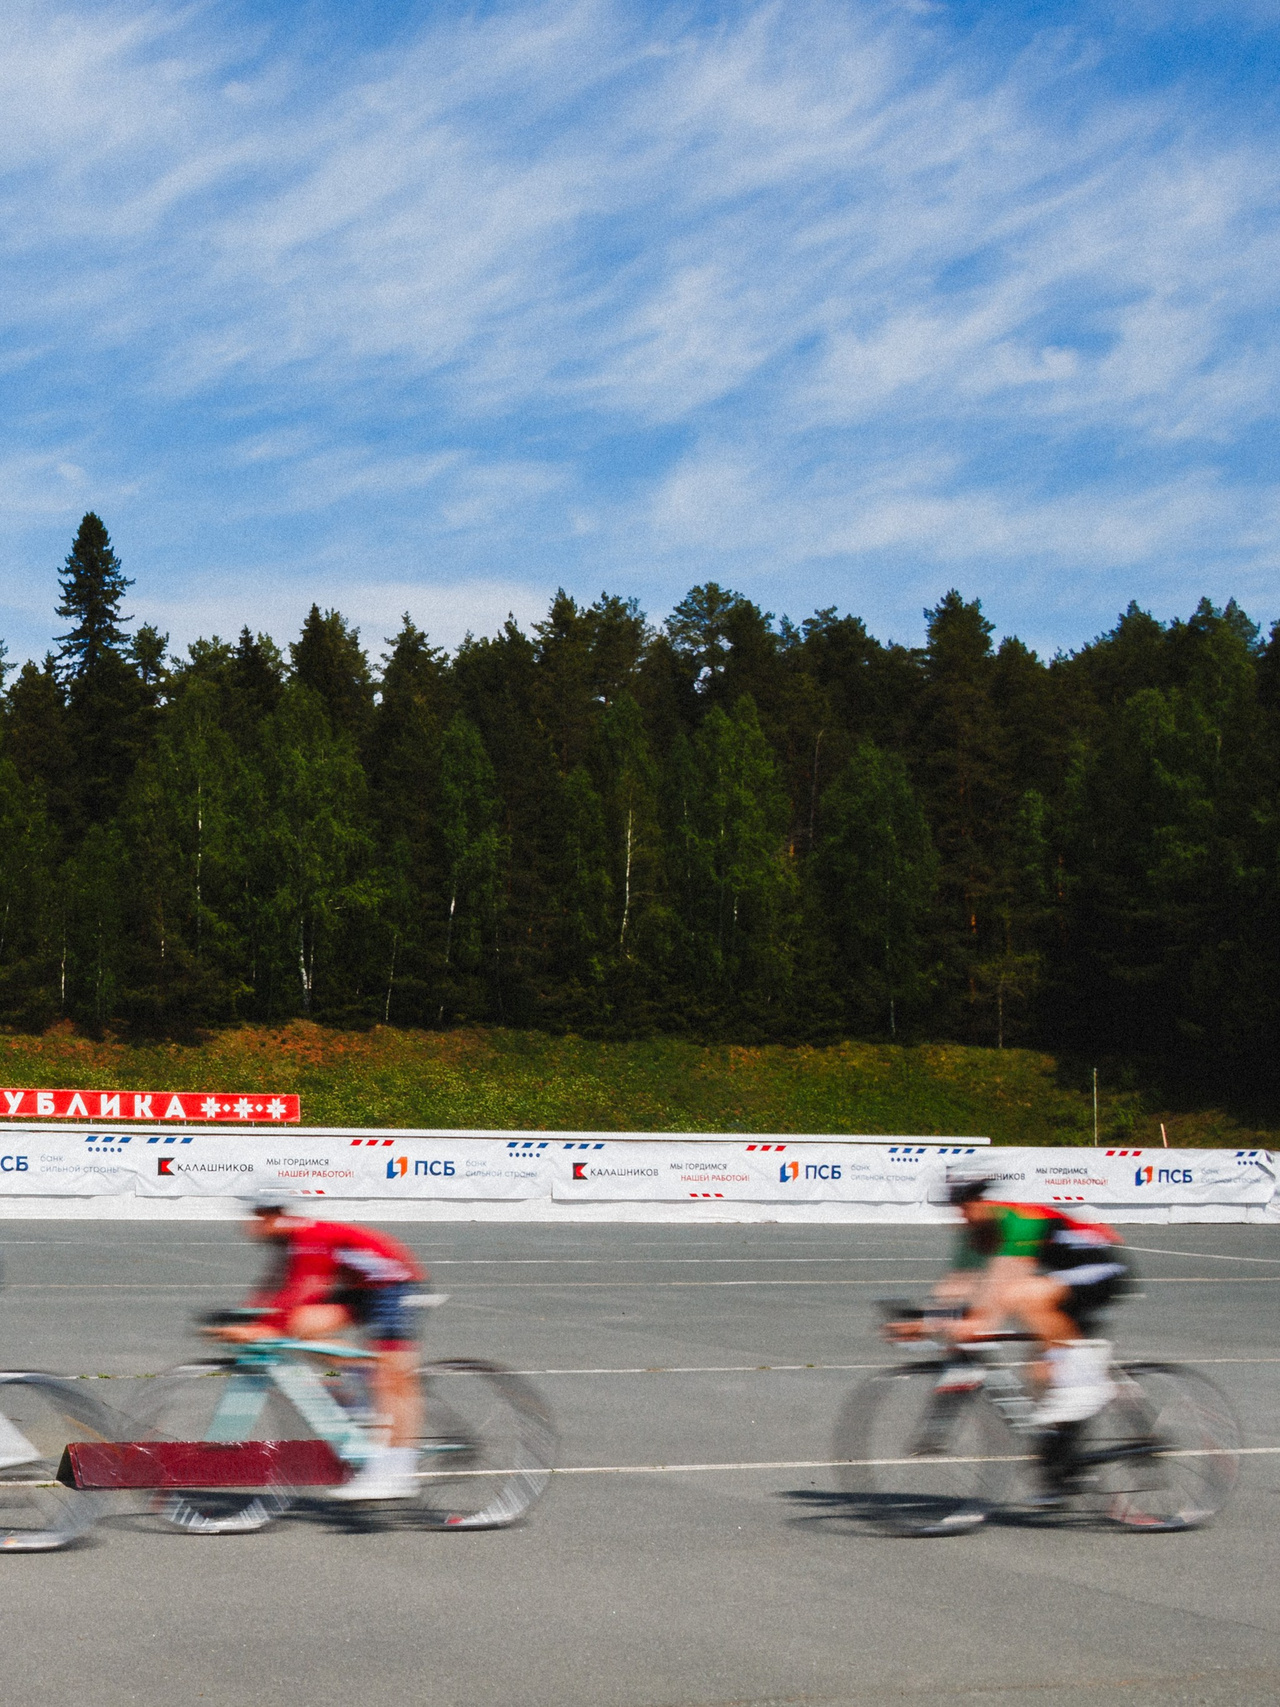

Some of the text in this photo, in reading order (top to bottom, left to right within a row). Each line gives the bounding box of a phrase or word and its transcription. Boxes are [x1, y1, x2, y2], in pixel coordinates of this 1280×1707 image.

[41, 1154, 64, 1162] банк
[266, 1157, 329, 1167] МЫ ГОРДИМСЯ
[466, 1158, 487, 1166] банк
[41, 1165, 82, 1174] сильной
[177, 1162, 254, 1172] КАЛАШНИКОВ
[414, 1160, 455, 1176] ПСБ
[590, 1167, 659, 1177] КАЛАШНИКОВ
[685, 1163, 727, 1171] ГОРДИМСЯ
[1049, 1167, 1088, 1175] ГОРДИМСЯ
[277, 1168, 355, 1178] НАШЕЙ РАБОТОЙ!
[681, 1172, 750, 1182] НАШЕЙ РАБОТОЙ!
[805, 1165, 842, 1180] ПСБ
[1158, 1169, 1193, 1184] ПСБ
[1044, 1176, 1109, 1185] НАШЕЙ РАБОТОЙ!
